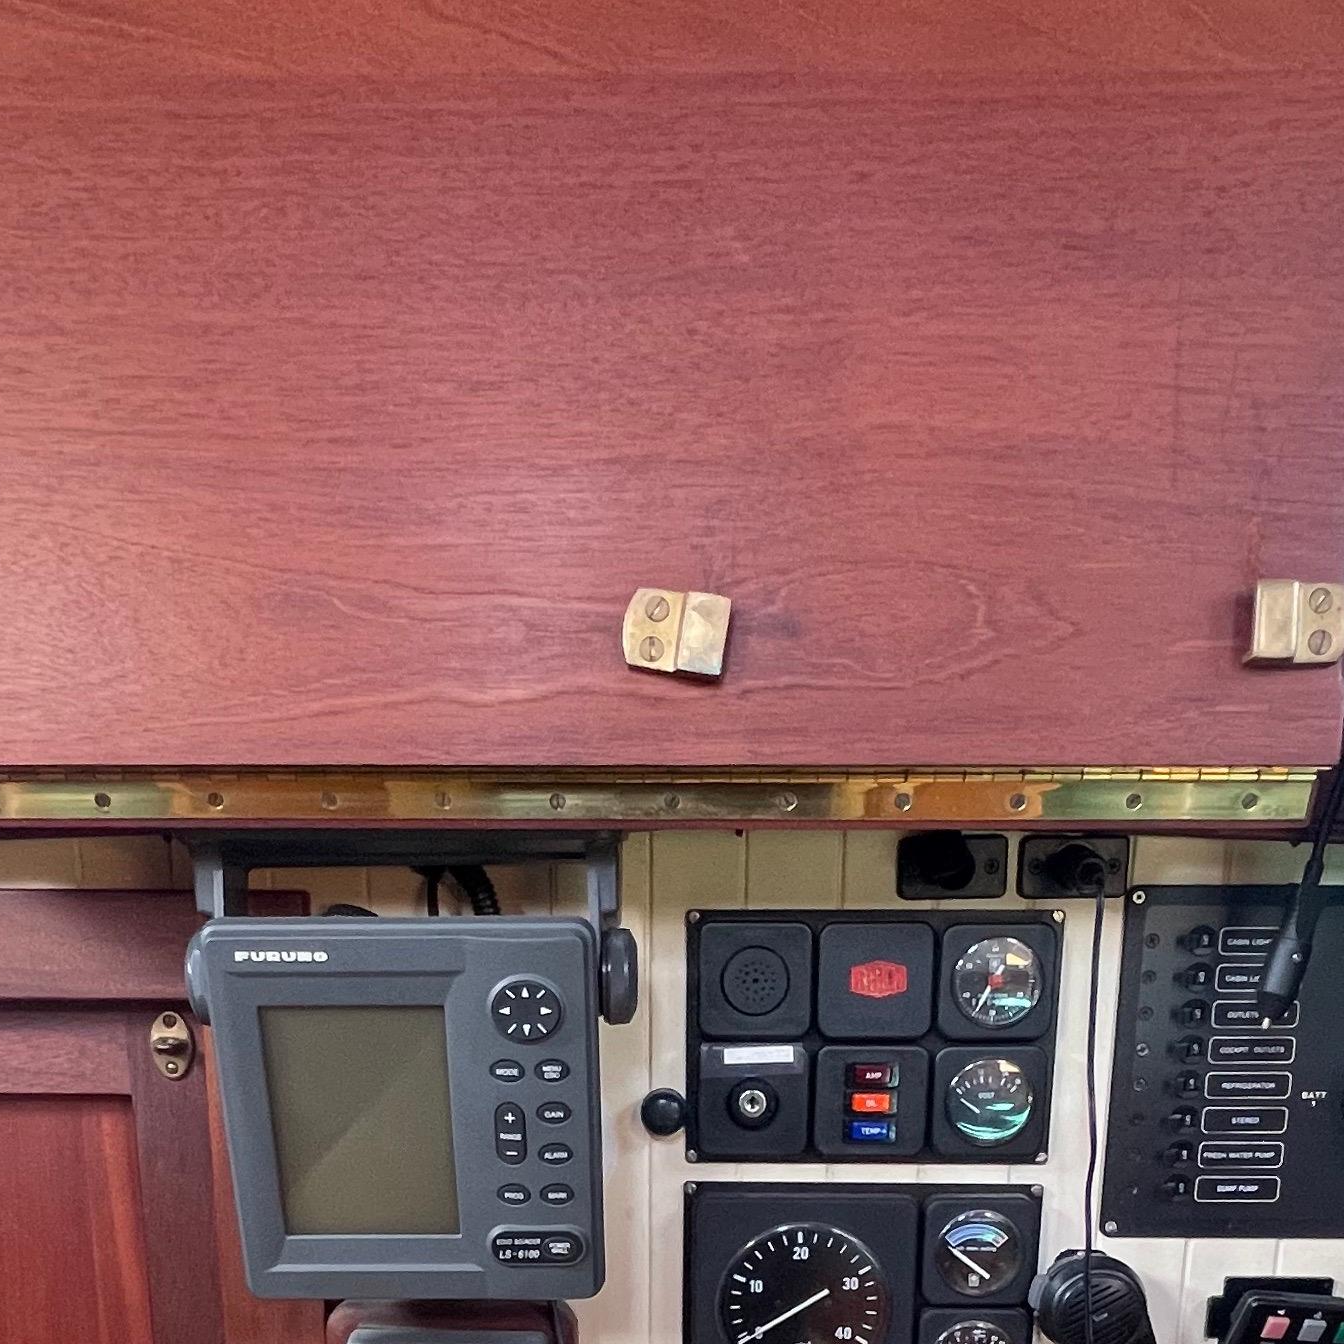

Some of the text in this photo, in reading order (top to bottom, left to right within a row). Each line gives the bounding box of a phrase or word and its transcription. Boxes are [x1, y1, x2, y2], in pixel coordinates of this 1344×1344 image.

[234, 951, 328, 962] FURUNO
[1301, 1091, 1327, 1100] BATT
[792, 1247, 809, 1260] 20
[749, 1279, 763, 1293] 10
[842, 1277, 859, 1290] 30
[834, 1326, 852, 1340] 40
